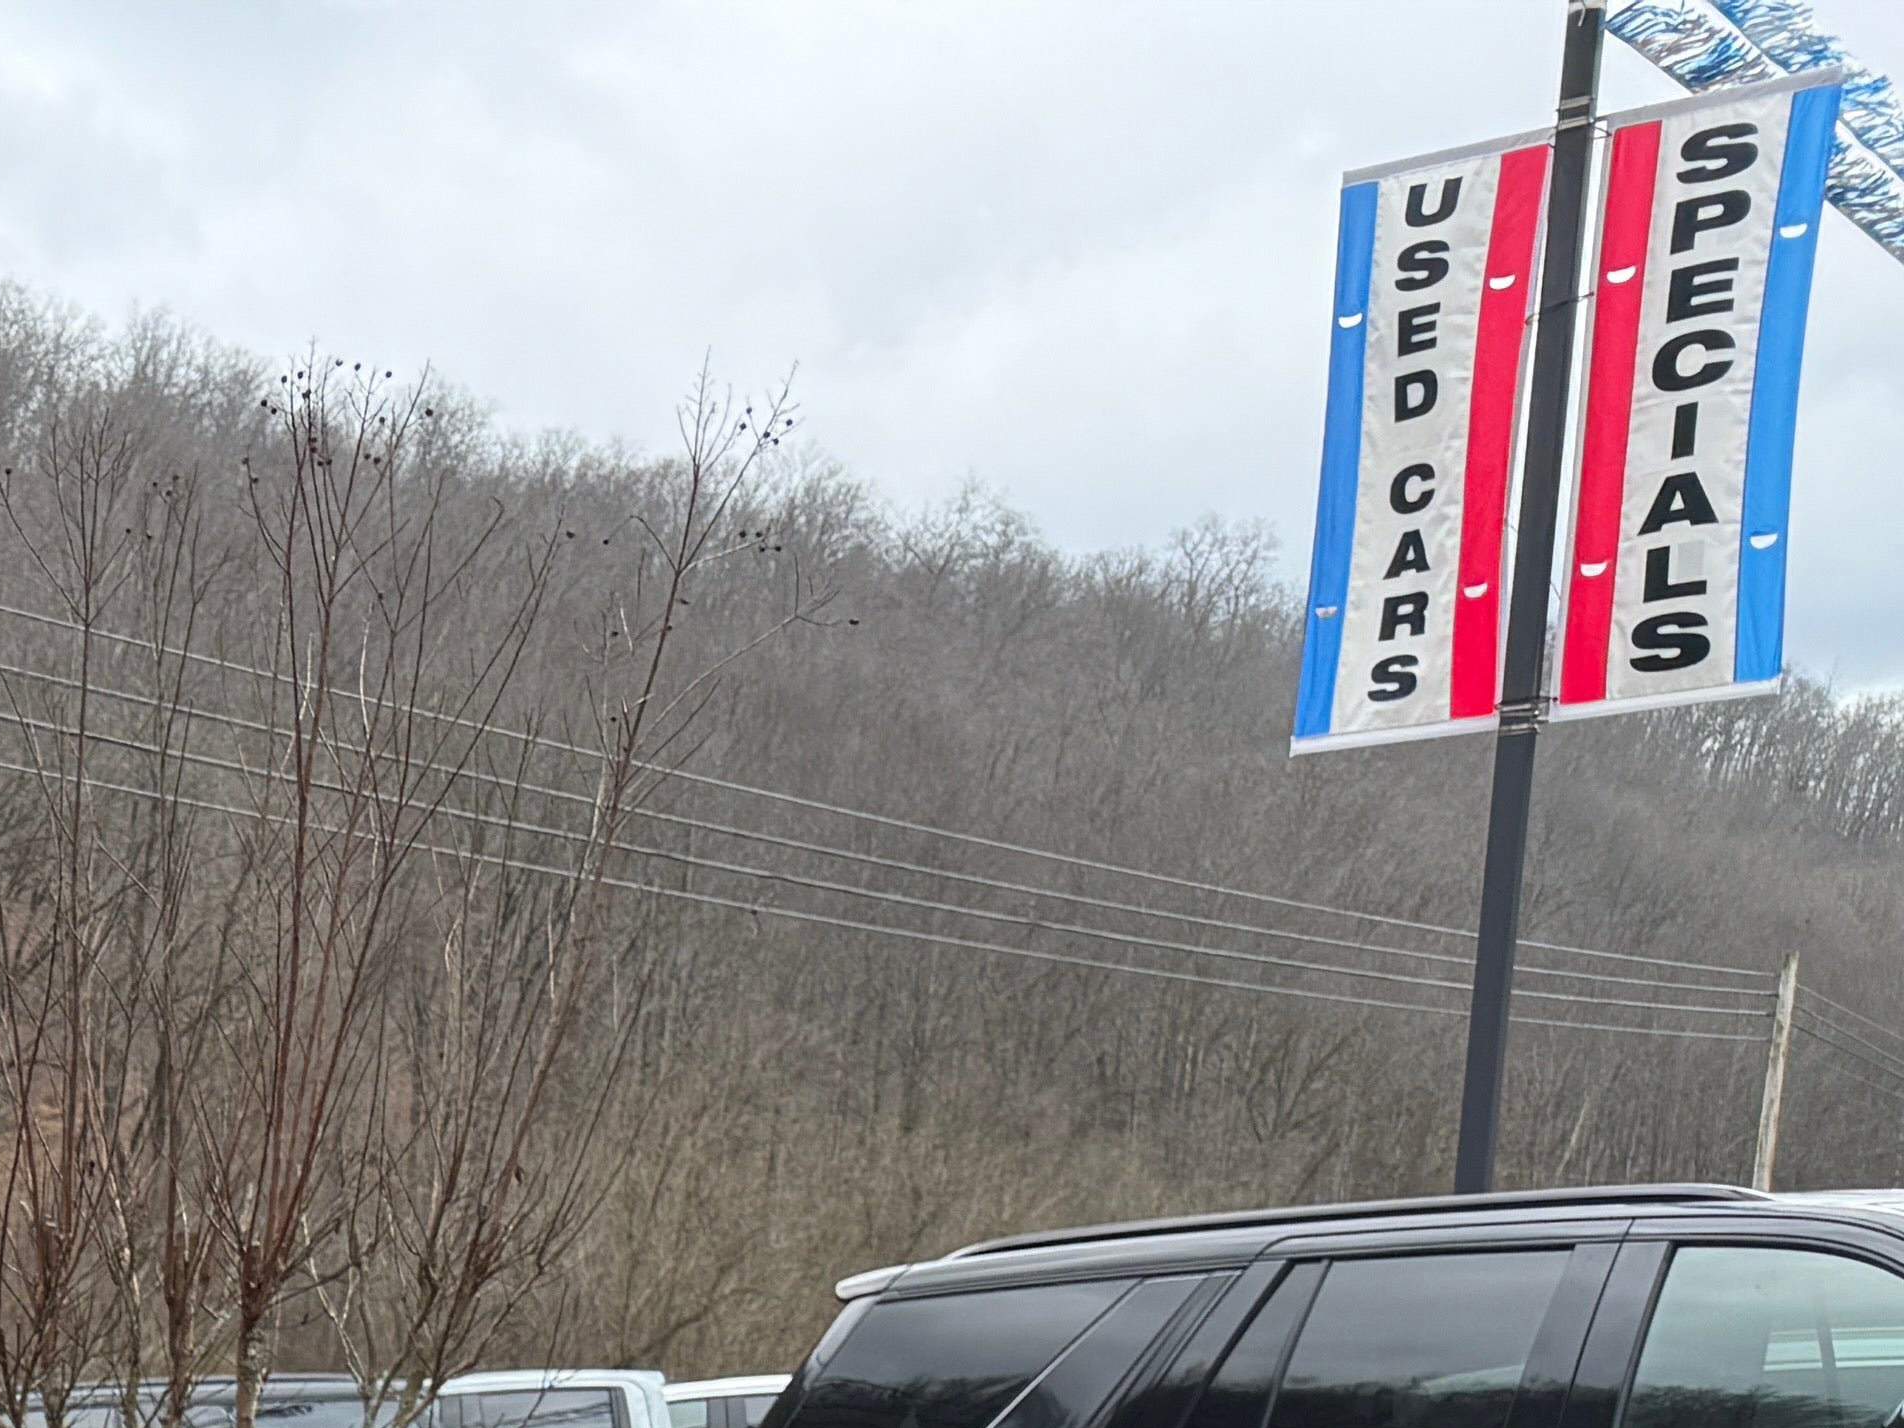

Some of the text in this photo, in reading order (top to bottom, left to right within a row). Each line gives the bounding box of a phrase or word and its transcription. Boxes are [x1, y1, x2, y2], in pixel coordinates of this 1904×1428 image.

[1367, 176, 1463, 703] USED CARS
[1628, 122, 1760, 674] SPECIALS
